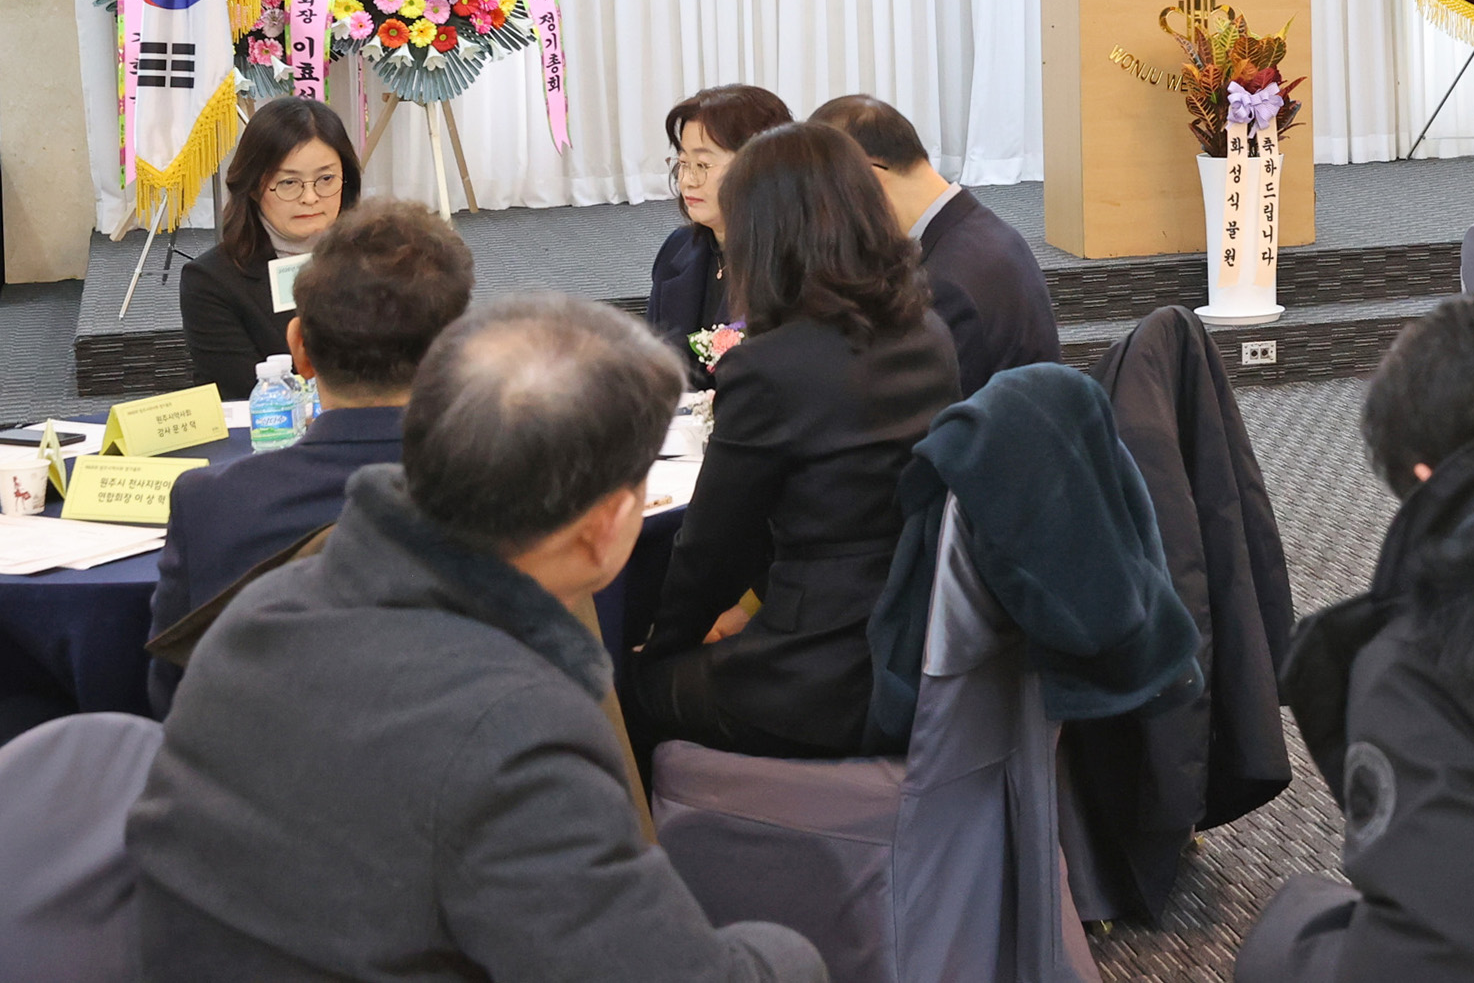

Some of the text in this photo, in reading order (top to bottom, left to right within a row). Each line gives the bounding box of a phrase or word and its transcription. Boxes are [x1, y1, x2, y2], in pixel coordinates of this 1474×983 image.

[538, 10, 562, 93] 정기총회
[1108, 44, 1164, 85] WONJU
[1223, 136, 1244, 268] 화성식물원
[1262, 136, 1277, 267] 축하드립니다
[100, 478, 126, 488] 원주시
